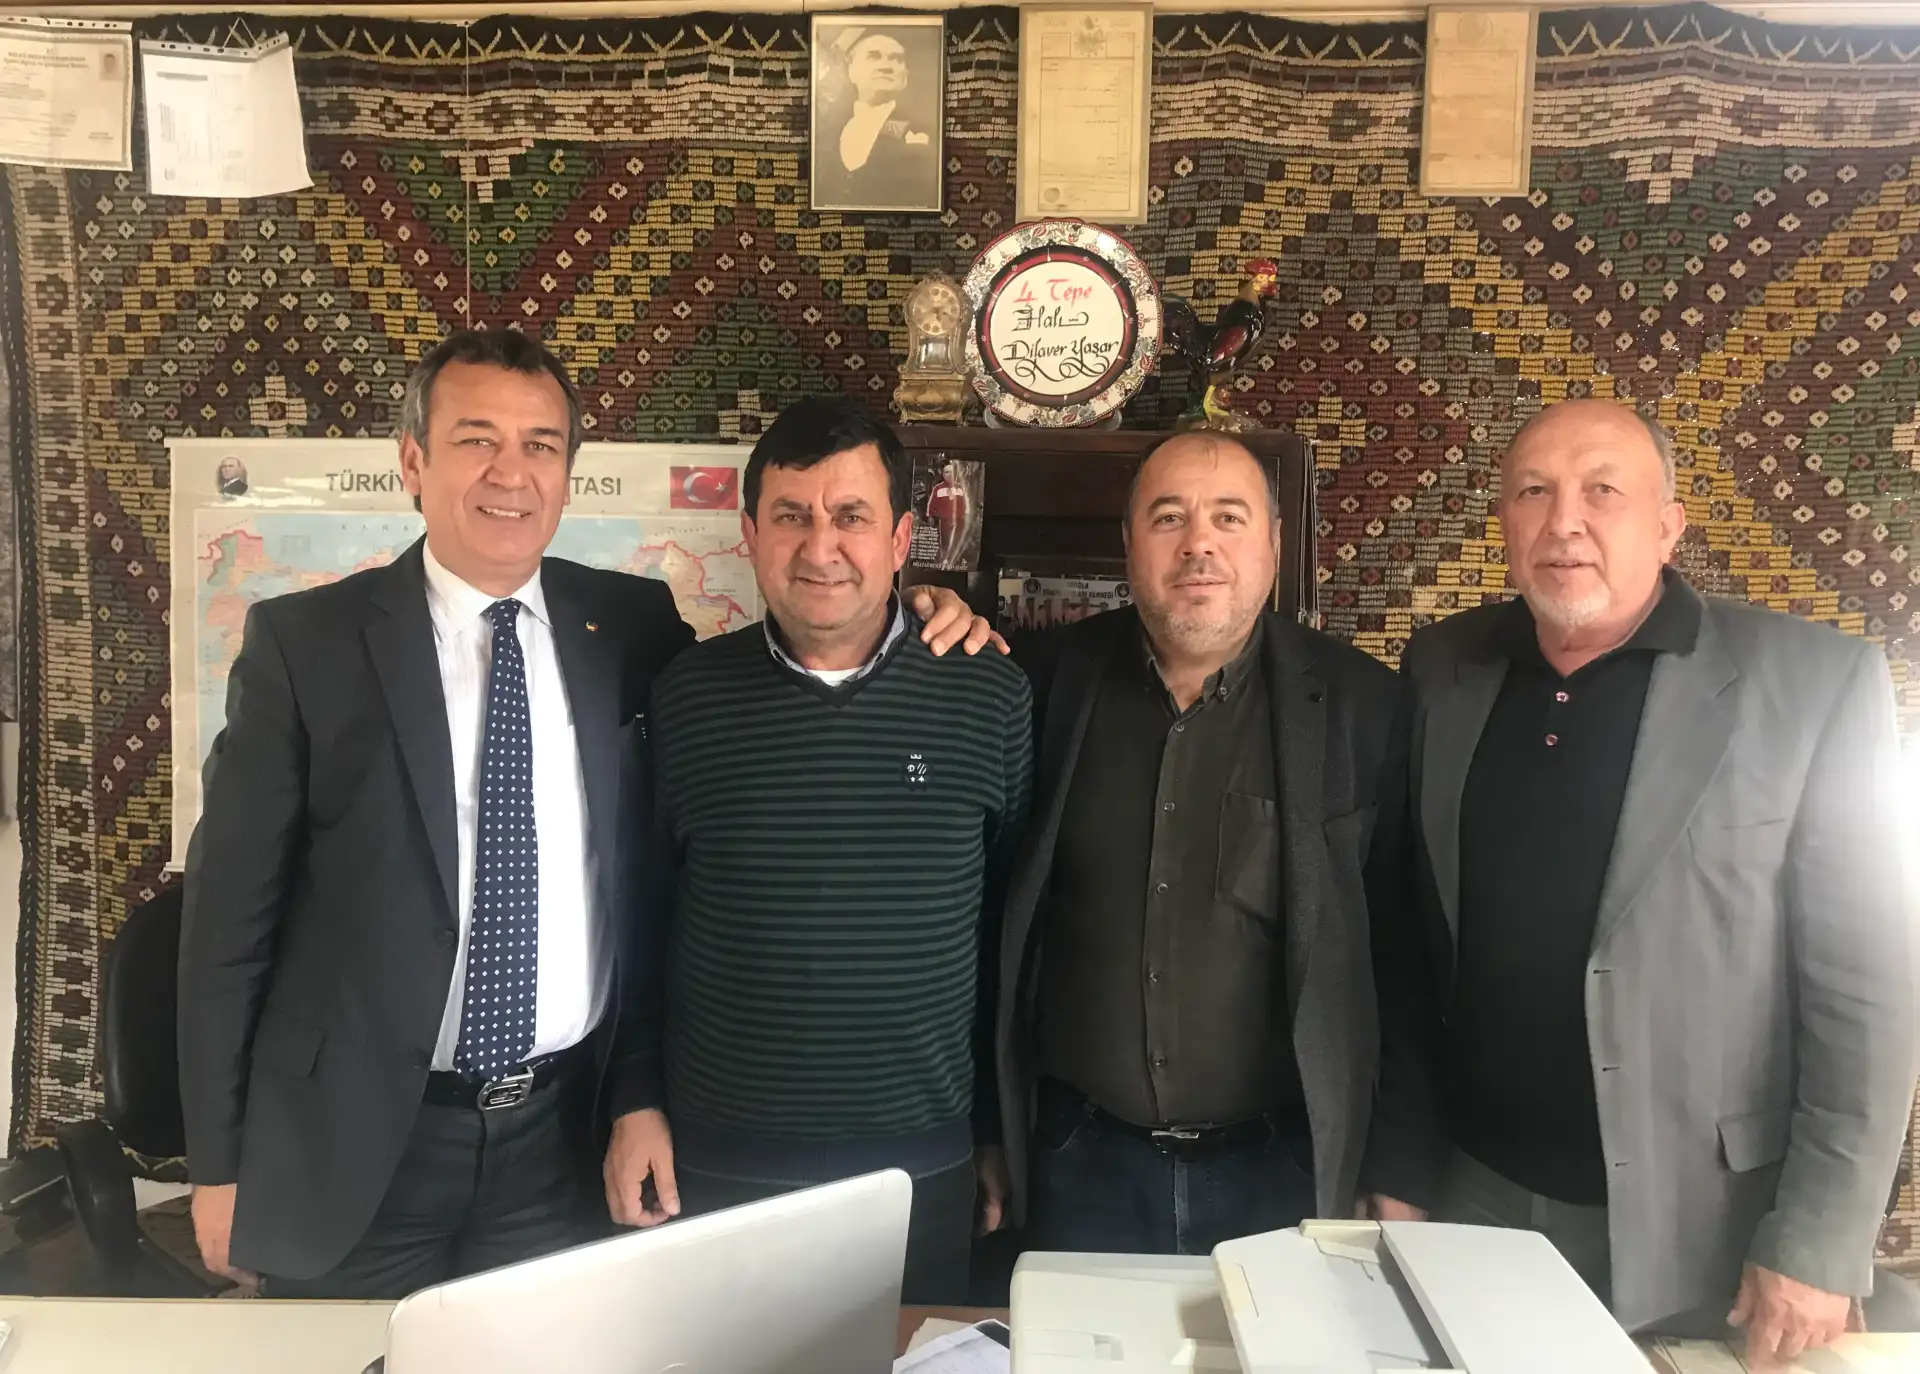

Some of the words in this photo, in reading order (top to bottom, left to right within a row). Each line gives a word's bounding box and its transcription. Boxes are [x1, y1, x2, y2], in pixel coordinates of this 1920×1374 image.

[1013, 279, 1039, 304] 4
[1047, 278, 1093, 308] Tepe
[1000, 337, 1067, 374] Dilaver
[1071, 336, 1120, 370] Yaşar
[570, 475, 622, 496] TASI
